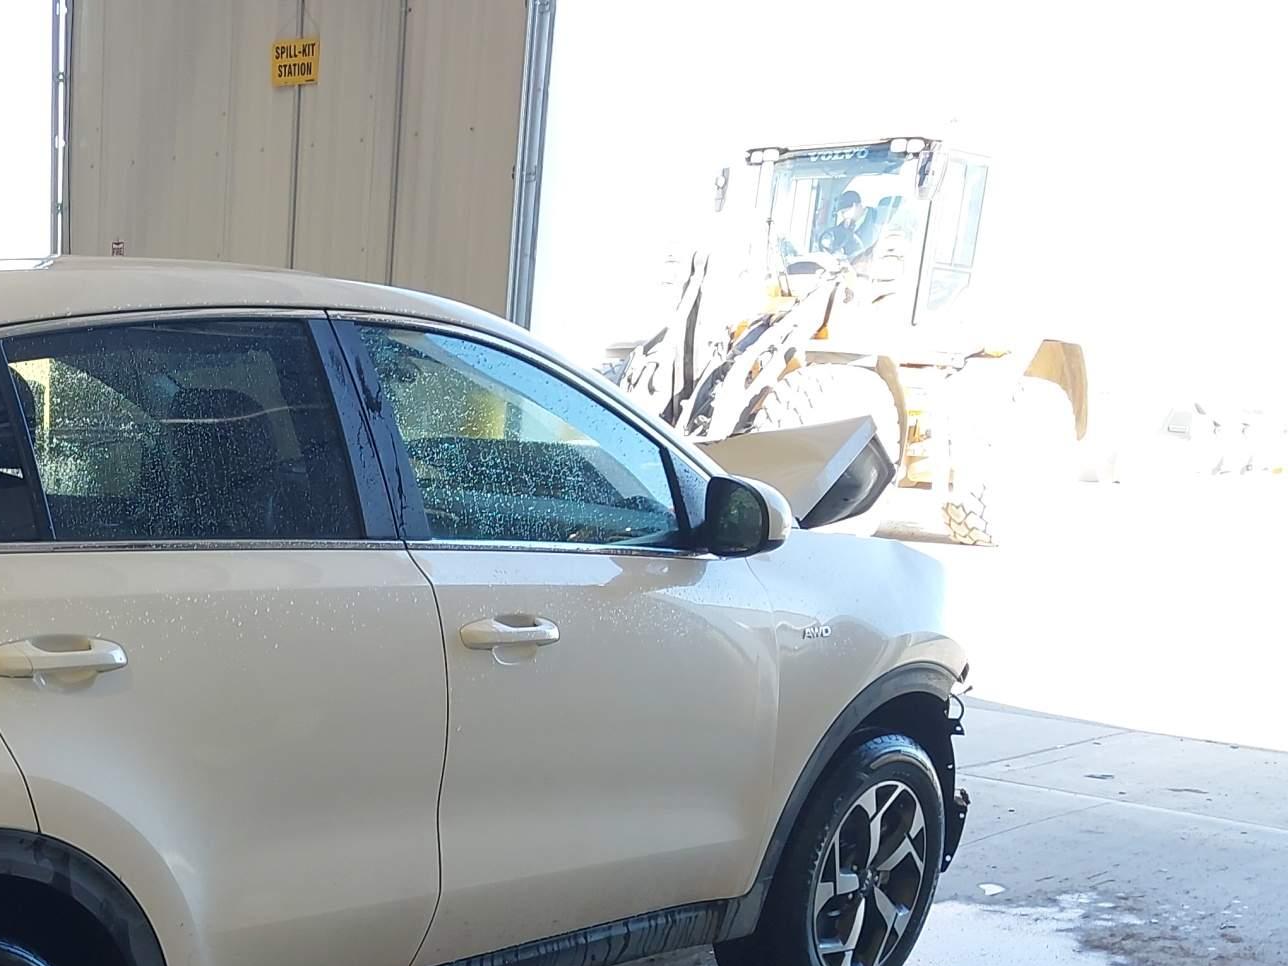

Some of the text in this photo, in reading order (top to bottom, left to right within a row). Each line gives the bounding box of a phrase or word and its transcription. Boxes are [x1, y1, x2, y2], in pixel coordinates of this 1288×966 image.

[275, 43, 315, 60] SPILL-KIT
[278, 62, 312, 78] STATION
[807, 147, 869, 162] VOLVO
[802, 625, 832, 640] AWD
